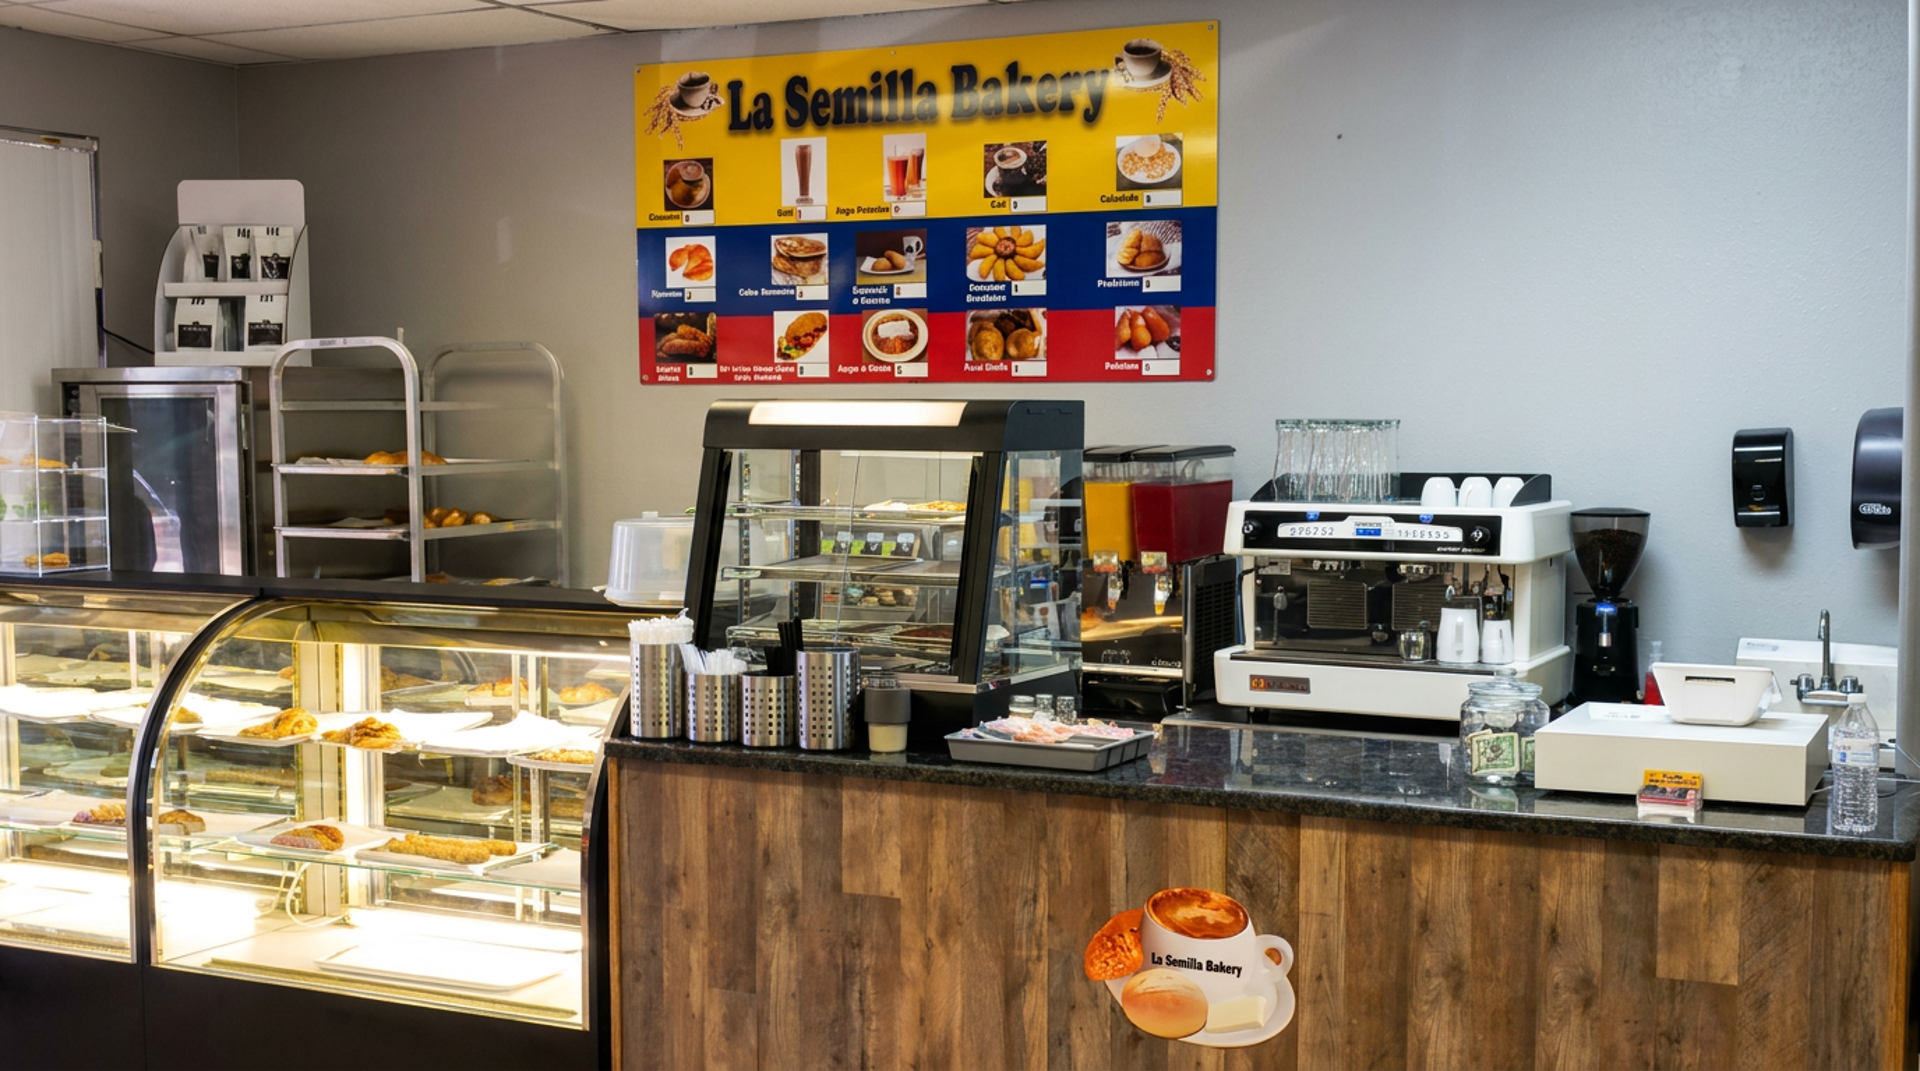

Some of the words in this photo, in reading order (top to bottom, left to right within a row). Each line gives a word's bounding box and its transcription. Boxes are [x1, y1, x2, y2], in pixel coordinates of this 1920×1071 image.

[728, 80, 773, 130] La
[784, 68, 939, 128] Semilla
[950, 61, 1110, 123] Bakery
[1151, 952, 1163, 965] La
[1165, 954, 1203, 971] Semilla
[1205, 960, 1242, 978] Bakery
